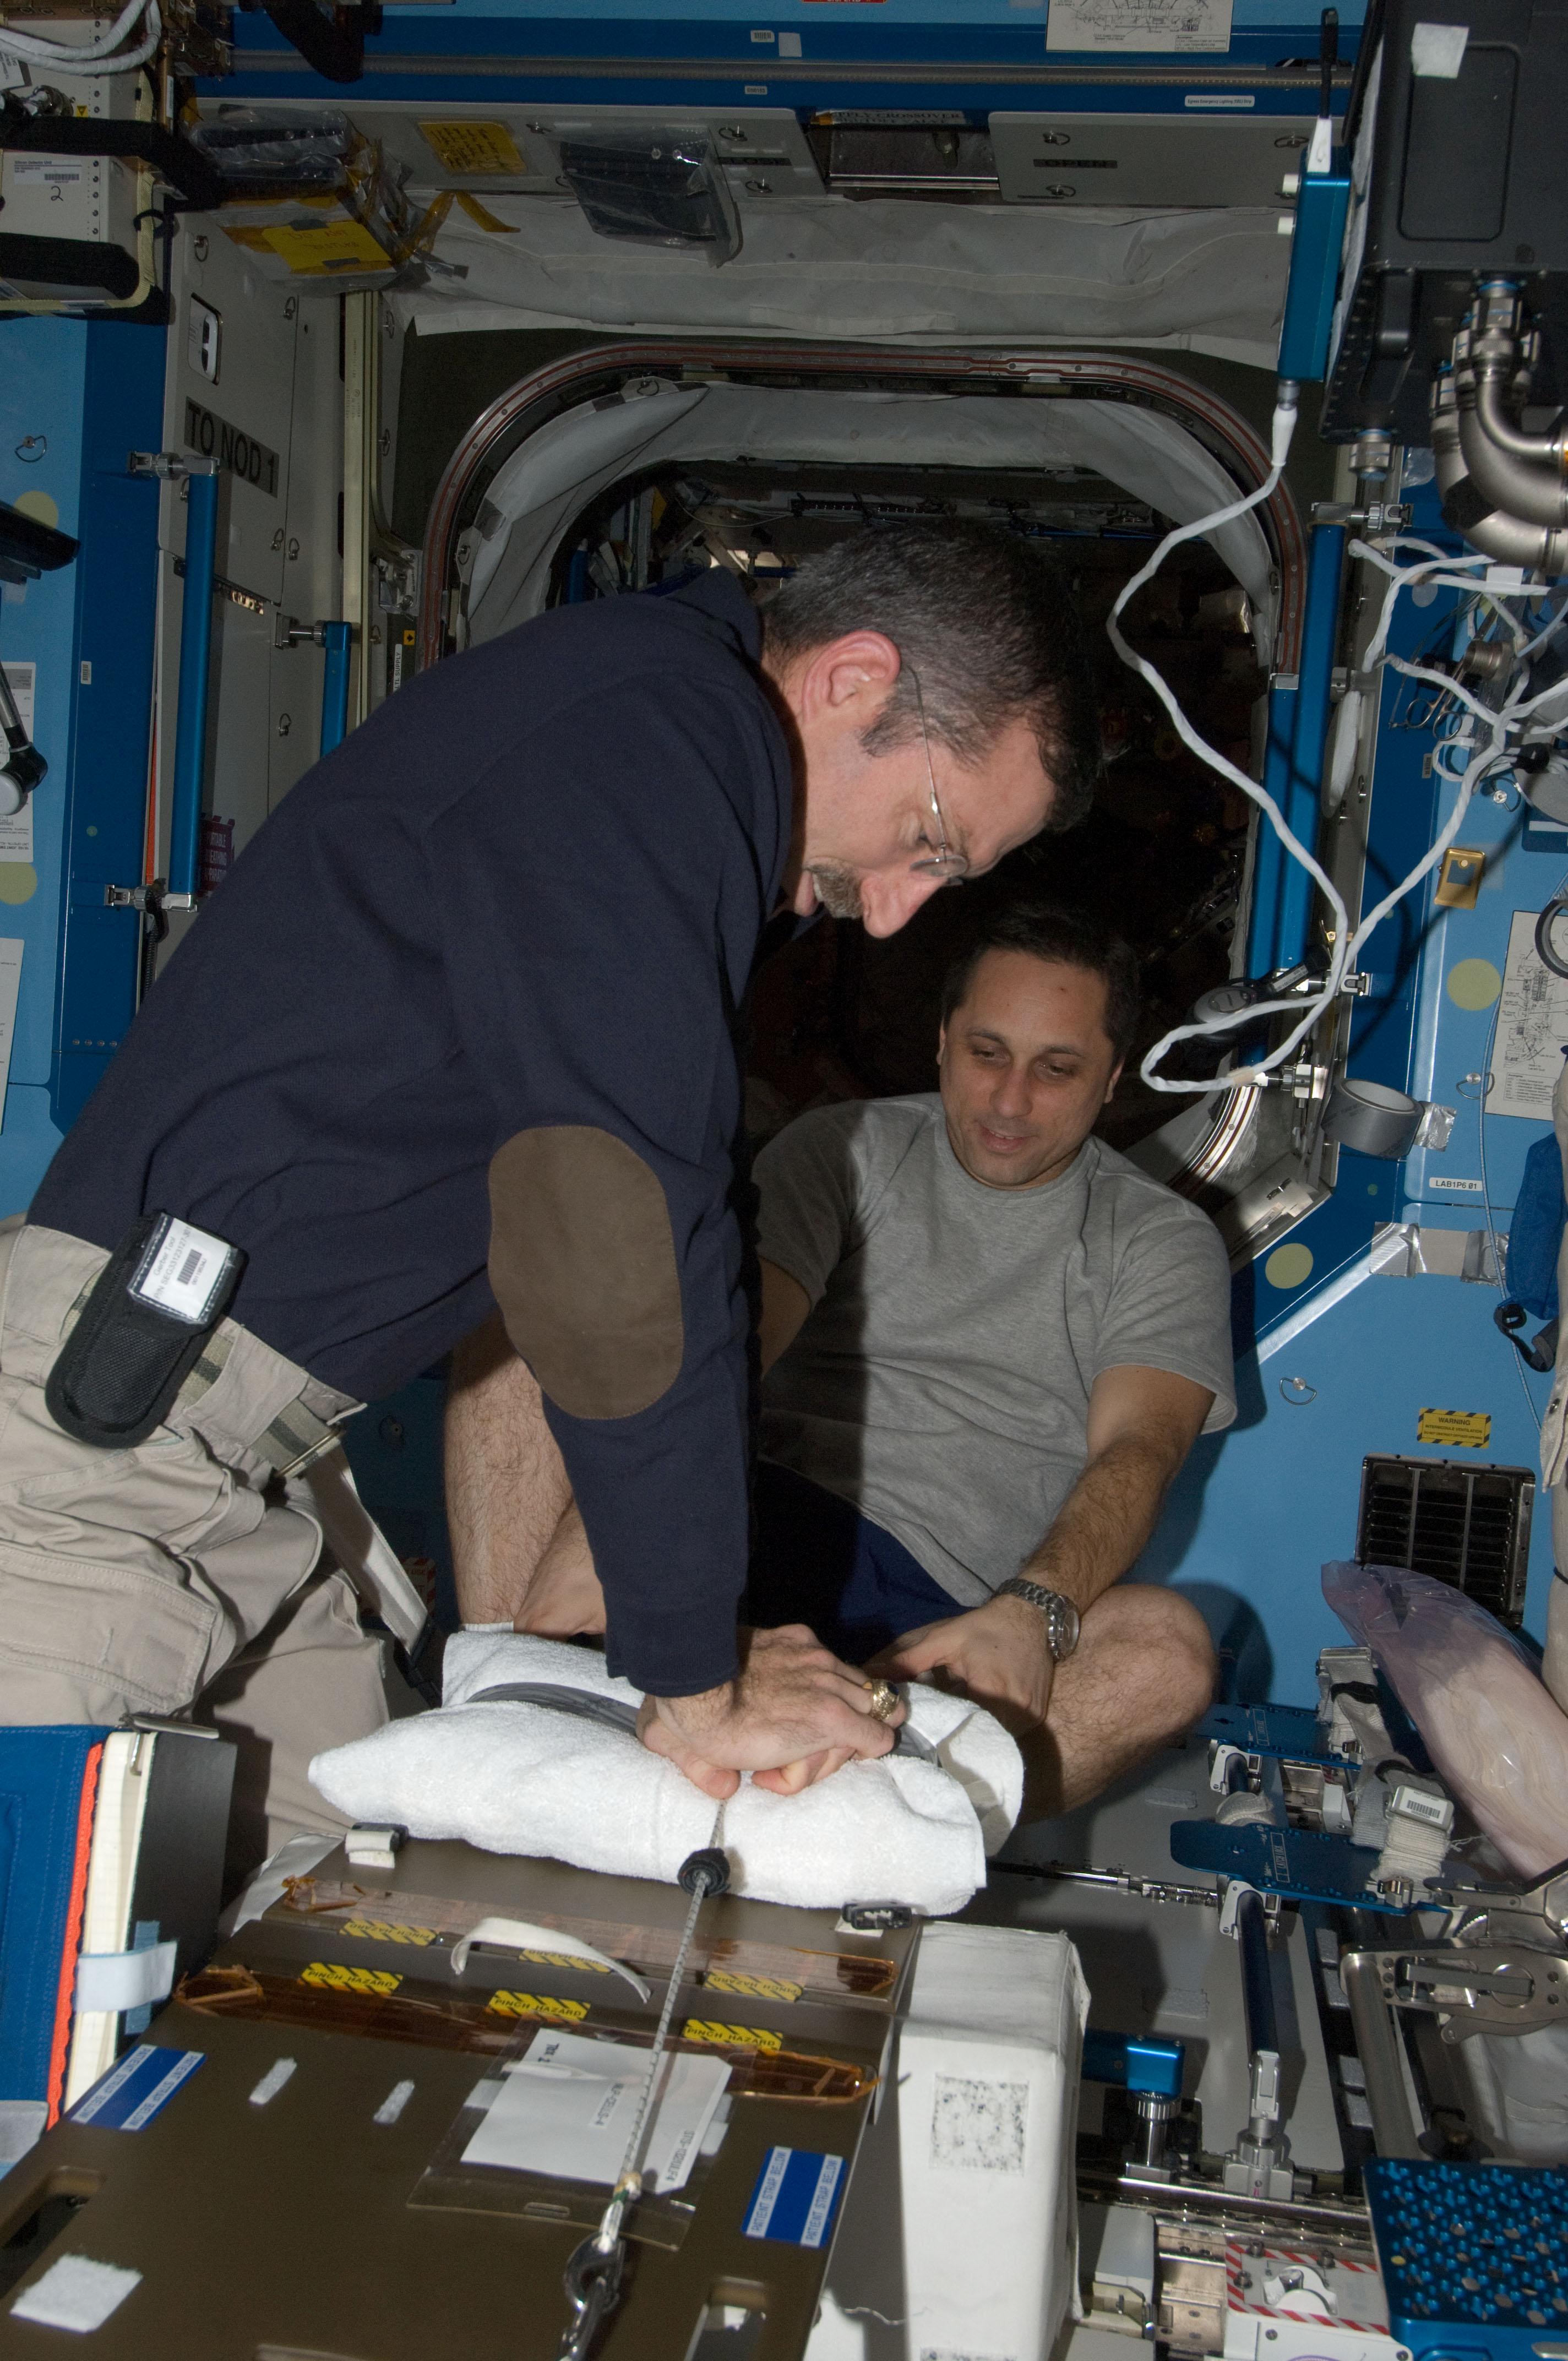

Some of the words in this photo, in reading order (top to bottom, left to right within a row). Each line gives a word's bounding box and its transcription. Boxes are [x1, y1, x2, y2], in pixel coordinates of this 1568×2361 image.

[51, 186, 64, 202] 2
[188, 400, 215, 456] TO
[221, 422, 262, 485] NOD
[1435, 1180, 1467, 1189] LAB1P6
[154, 1252, 169, 1276] Gerber
[167, 1236, 176, 1251] Tool
[154, 1286, 165, 1299] P/N
[1438, 1417, 1471, 1426] WARNING
[1273, 1845, 1284, 1856] LOCK
[1275, 1855, 1287, 1869] LATCH
[349, 1923, 393, 1934] HAZARD
[396, 1930, 431, 1939] PINCH
[308, 1971, 342, 1981] PINCH
[347, 1976, 393, 1987] HAZARD
[713, 1977, 758, 1988] HAZARD
[763, 1984, 797, 1995] PINCH
[495, 1999, 530, 2009] PINCH
[535, 2005, 581, 2016] HAZARD
[687, 2027, 723, 2039] PINCH
[728, 2034, 776, 2046] HAZARD
[122, 2047, 152, 2072] PATIENT
[170, 2055, 198, 2080] PATIENT
[104, 2072, 128, 2093] STRAP
[152, 2080, 175, 2102] STRAP
[78, 2094, 107, 2119] BELOW
[129, 2102, 155, 2126] BELOW
[751, 2201, 770, 2231] PATIENT
[761, 2177, 777, 2200] STRAP
[770, 2151, 786, 2175] BELOW
[805, 2211, 823, 2240] PATIENT
[815, 2185, 829, 2209] STRAP
[822, 2159, 838, 2184] BELOW
